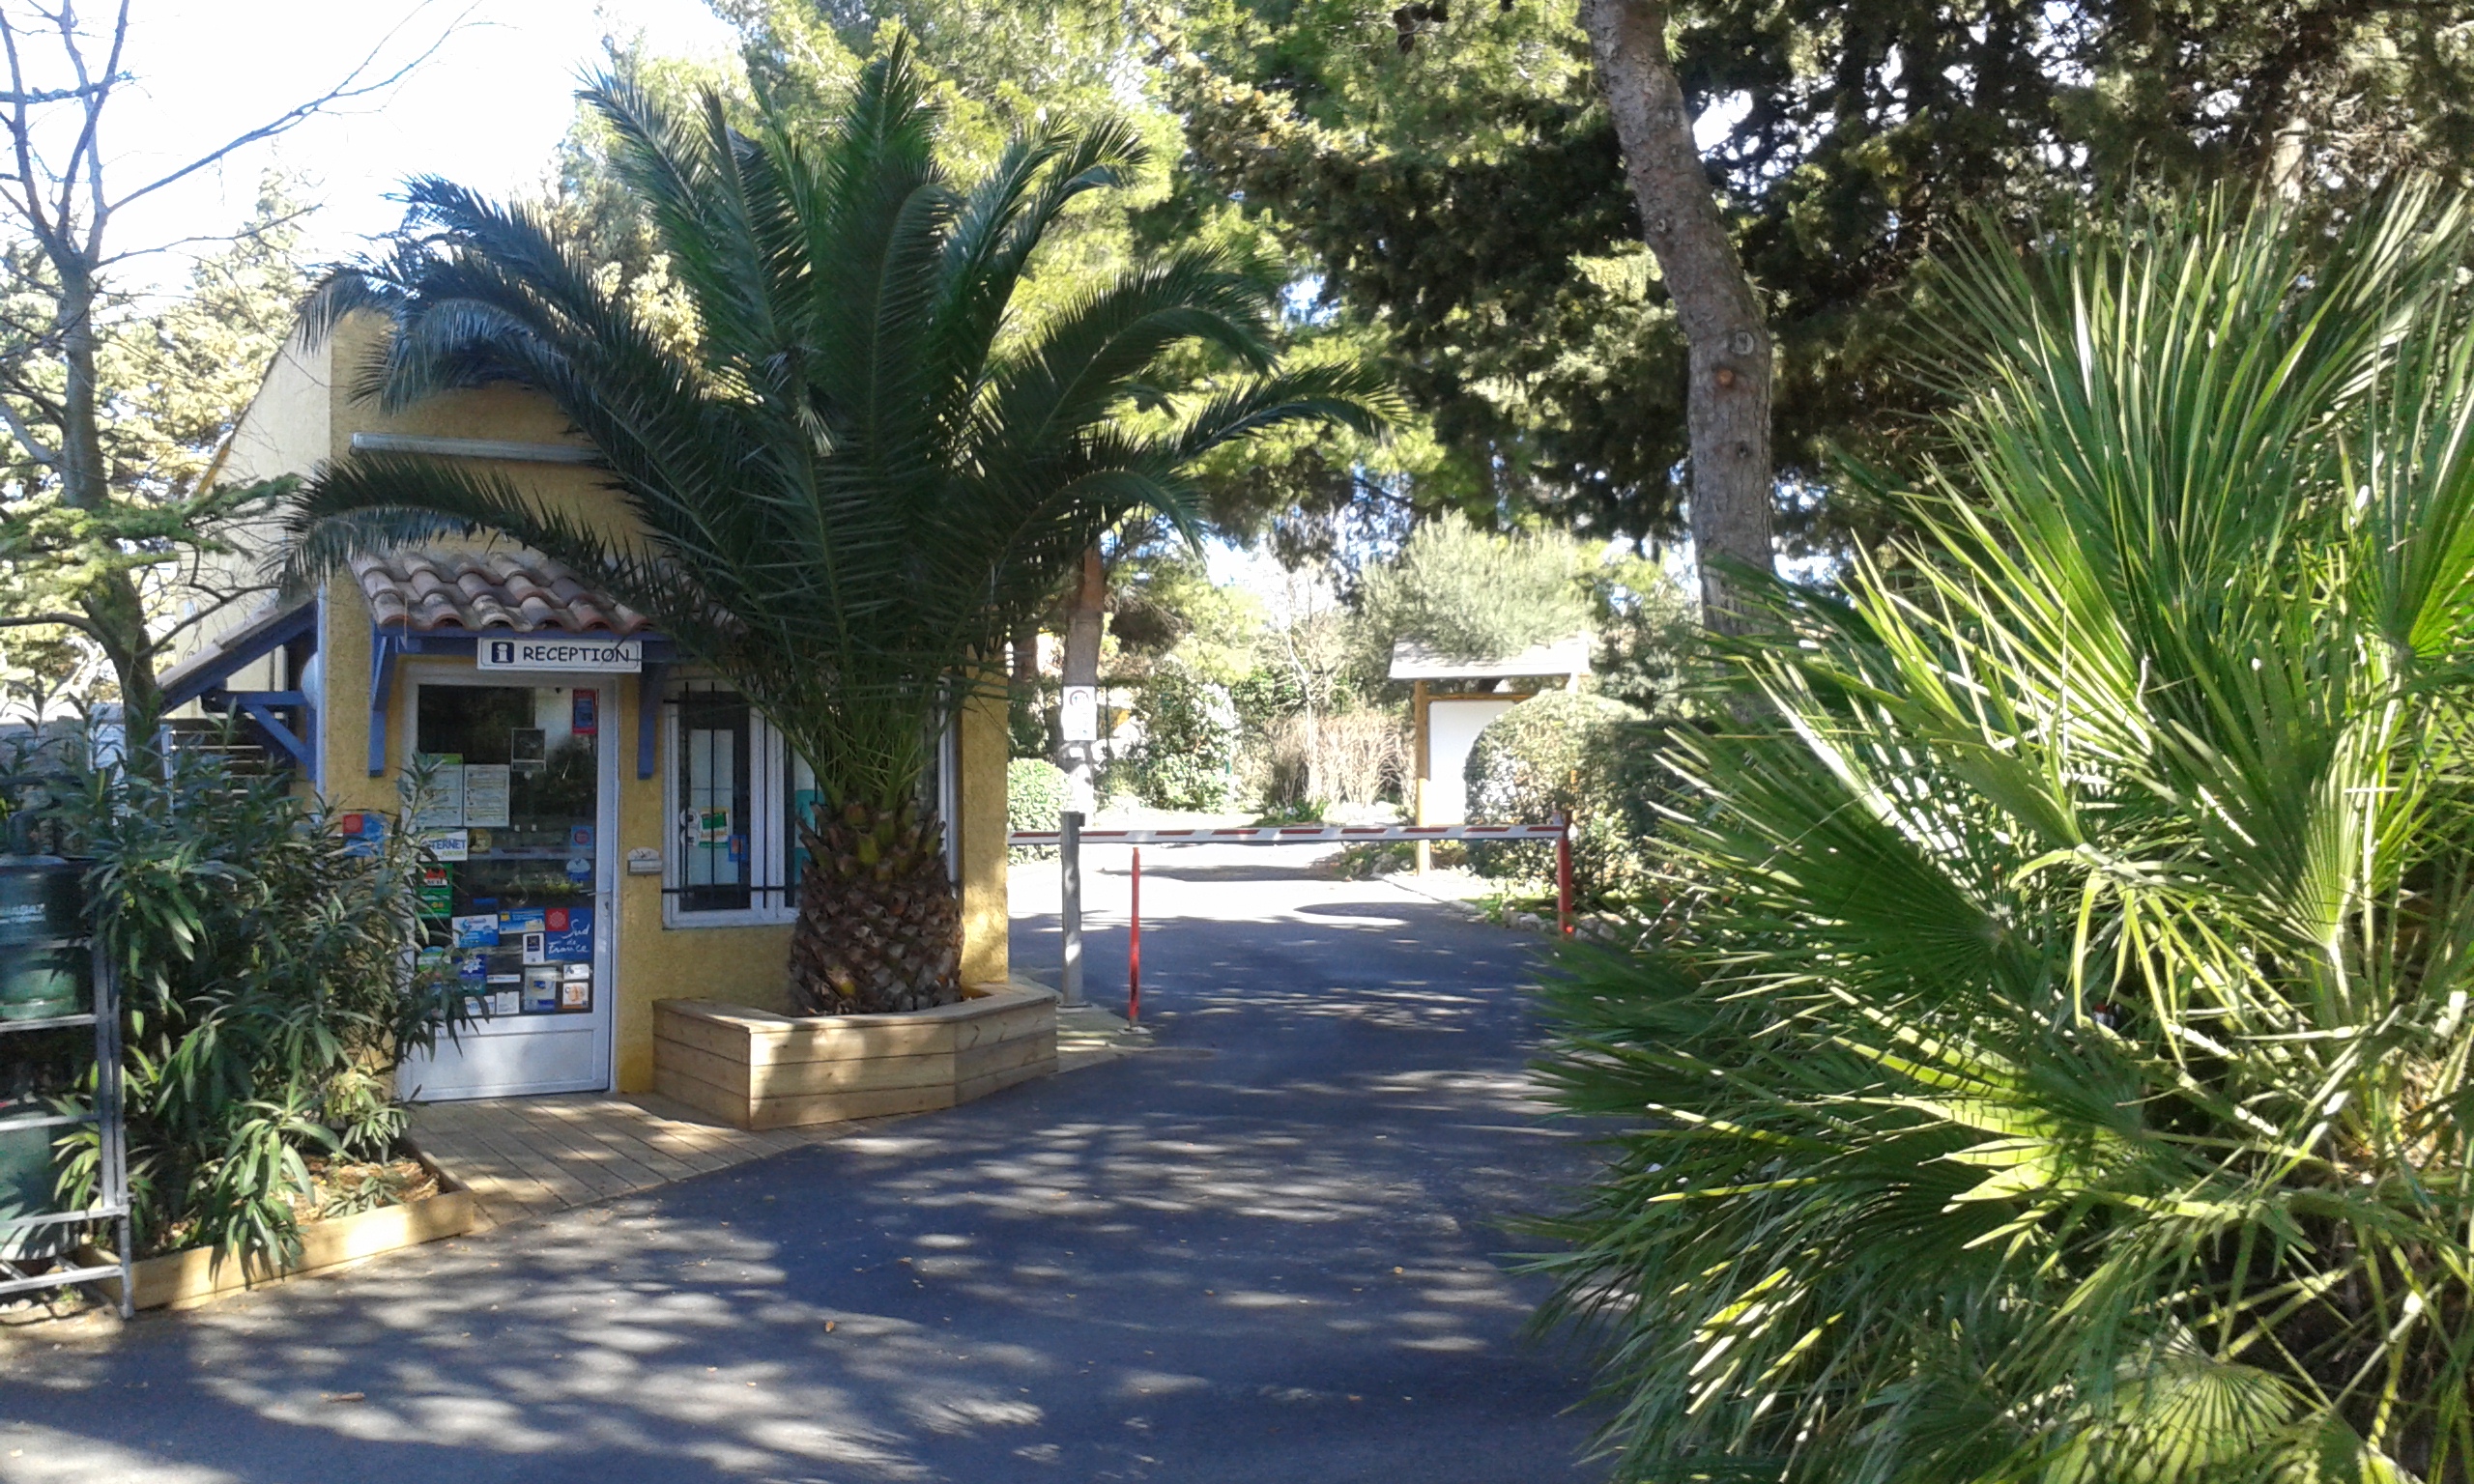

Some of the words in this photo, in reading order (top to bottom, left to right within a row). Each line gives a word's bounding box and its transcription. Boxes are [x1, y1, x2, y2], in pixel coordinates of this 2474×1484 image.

[523, 645, 629, 663] RECEPTION
[421, 838, 467, 850] TERNET
[561, 918, 590, 939] Sud
[547, 940, 590, 955] France
